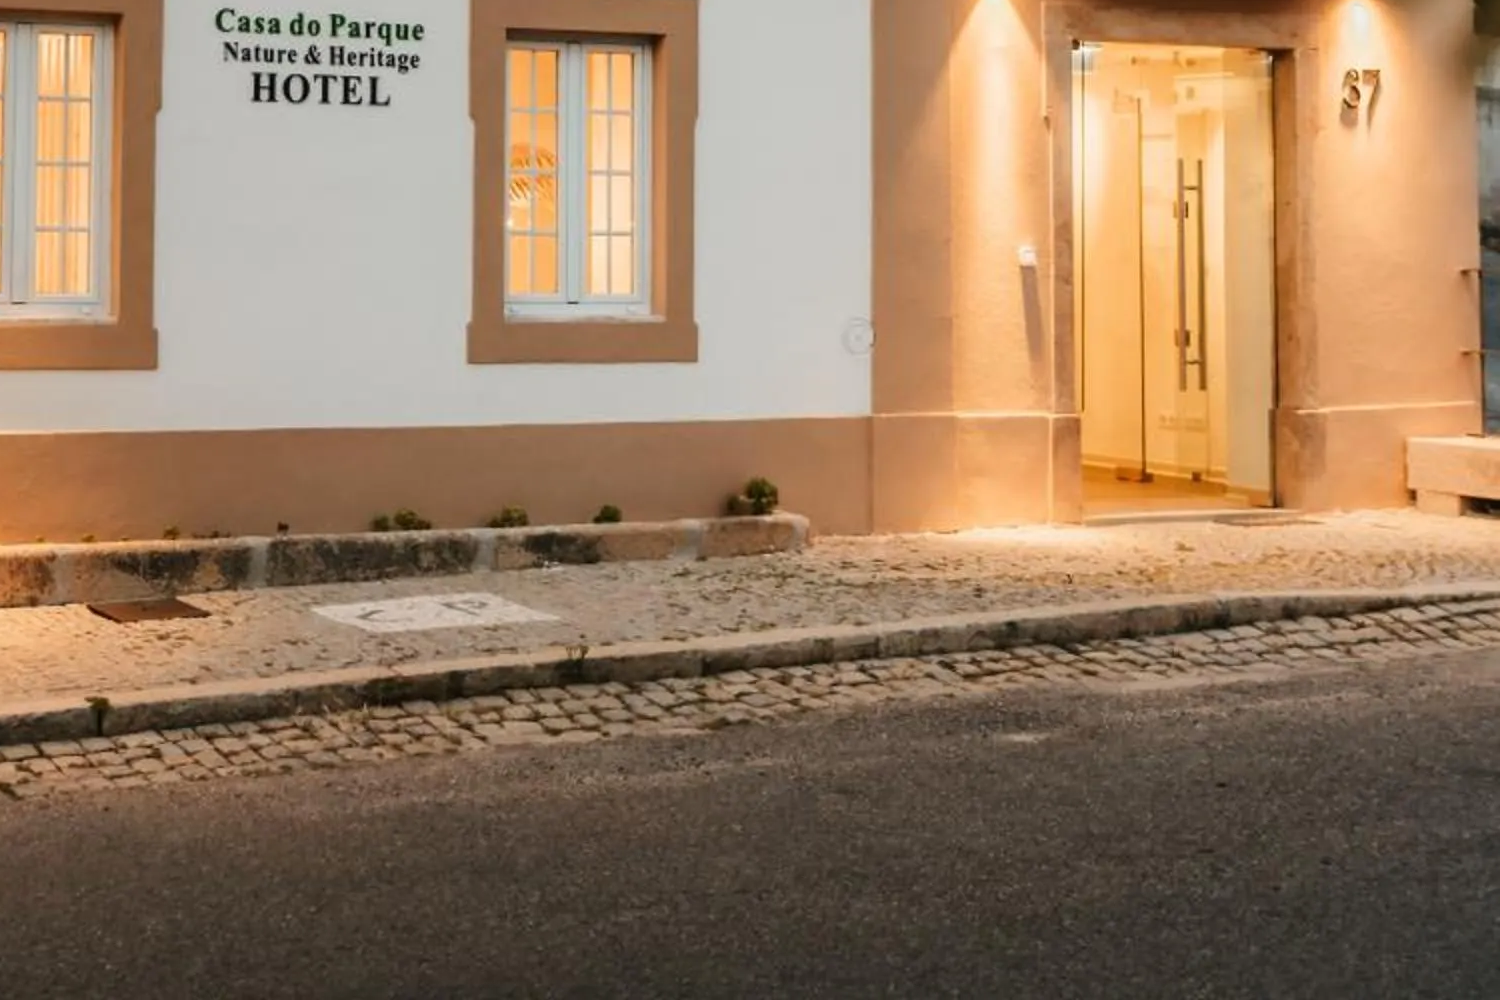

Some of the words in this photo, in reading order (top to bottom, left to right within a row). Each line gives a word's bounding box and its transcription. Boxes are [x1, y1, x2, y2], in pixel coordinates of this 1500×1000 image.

[214, 8, 281, 36] Casa
[289, 13, 321, 37] do
[329, 14, 425, 46] Parque
[223, 41, 298, 65] Nature
[304, 44, 322, 66] &
[329, 46, 421, 74] Heritage
[251, 72, 391, 107] HOTEL
[1342, 69, 1381, 109] 37
